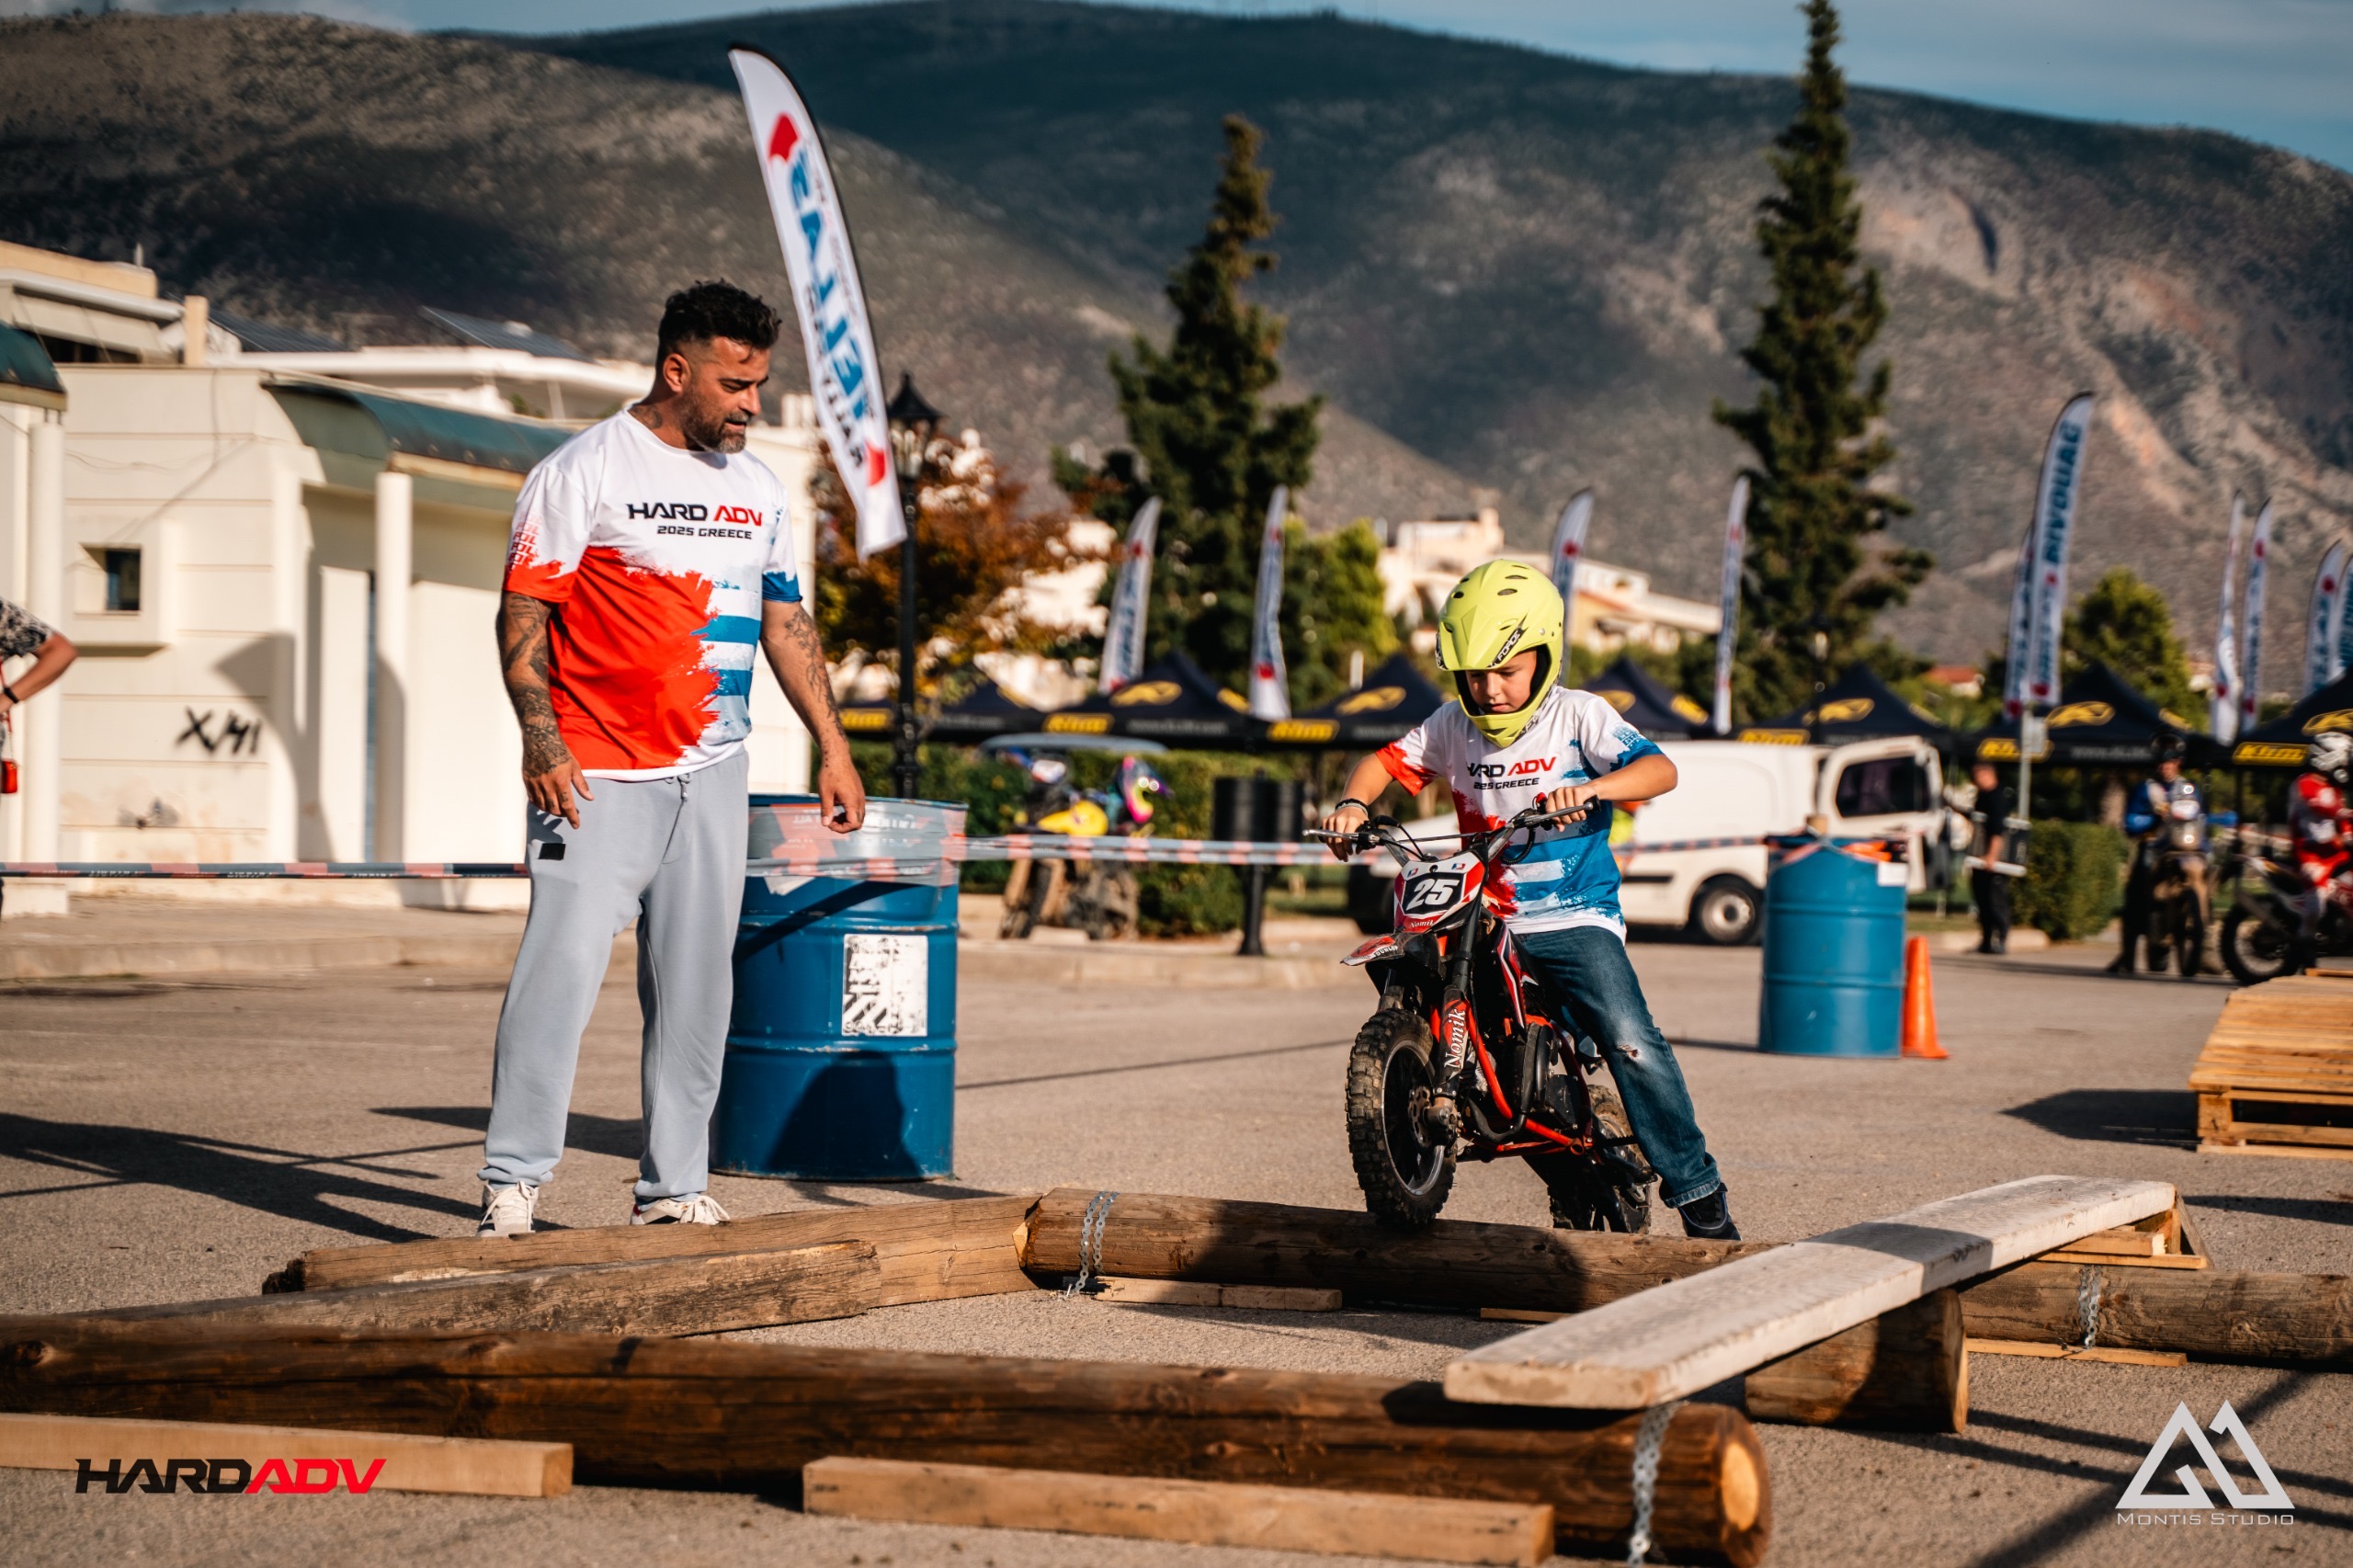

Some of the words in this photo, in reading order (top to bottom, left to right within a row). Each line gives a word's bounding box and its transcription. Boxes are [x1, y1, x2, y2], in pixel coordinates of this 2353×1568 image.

[625, 503, 708, 521] HARD
[713, 505, 762, 527] ADV
[656, 526, 695, 536] 2025
[698, 528, 753, 540] GREECE
[1507, 756, 1557, 777] ADV
[1495, 778, 1540, 790] GREECE
[1405, 878, 1461, 911] 25
[1444, 1008, 1466, 1068] Nomik
